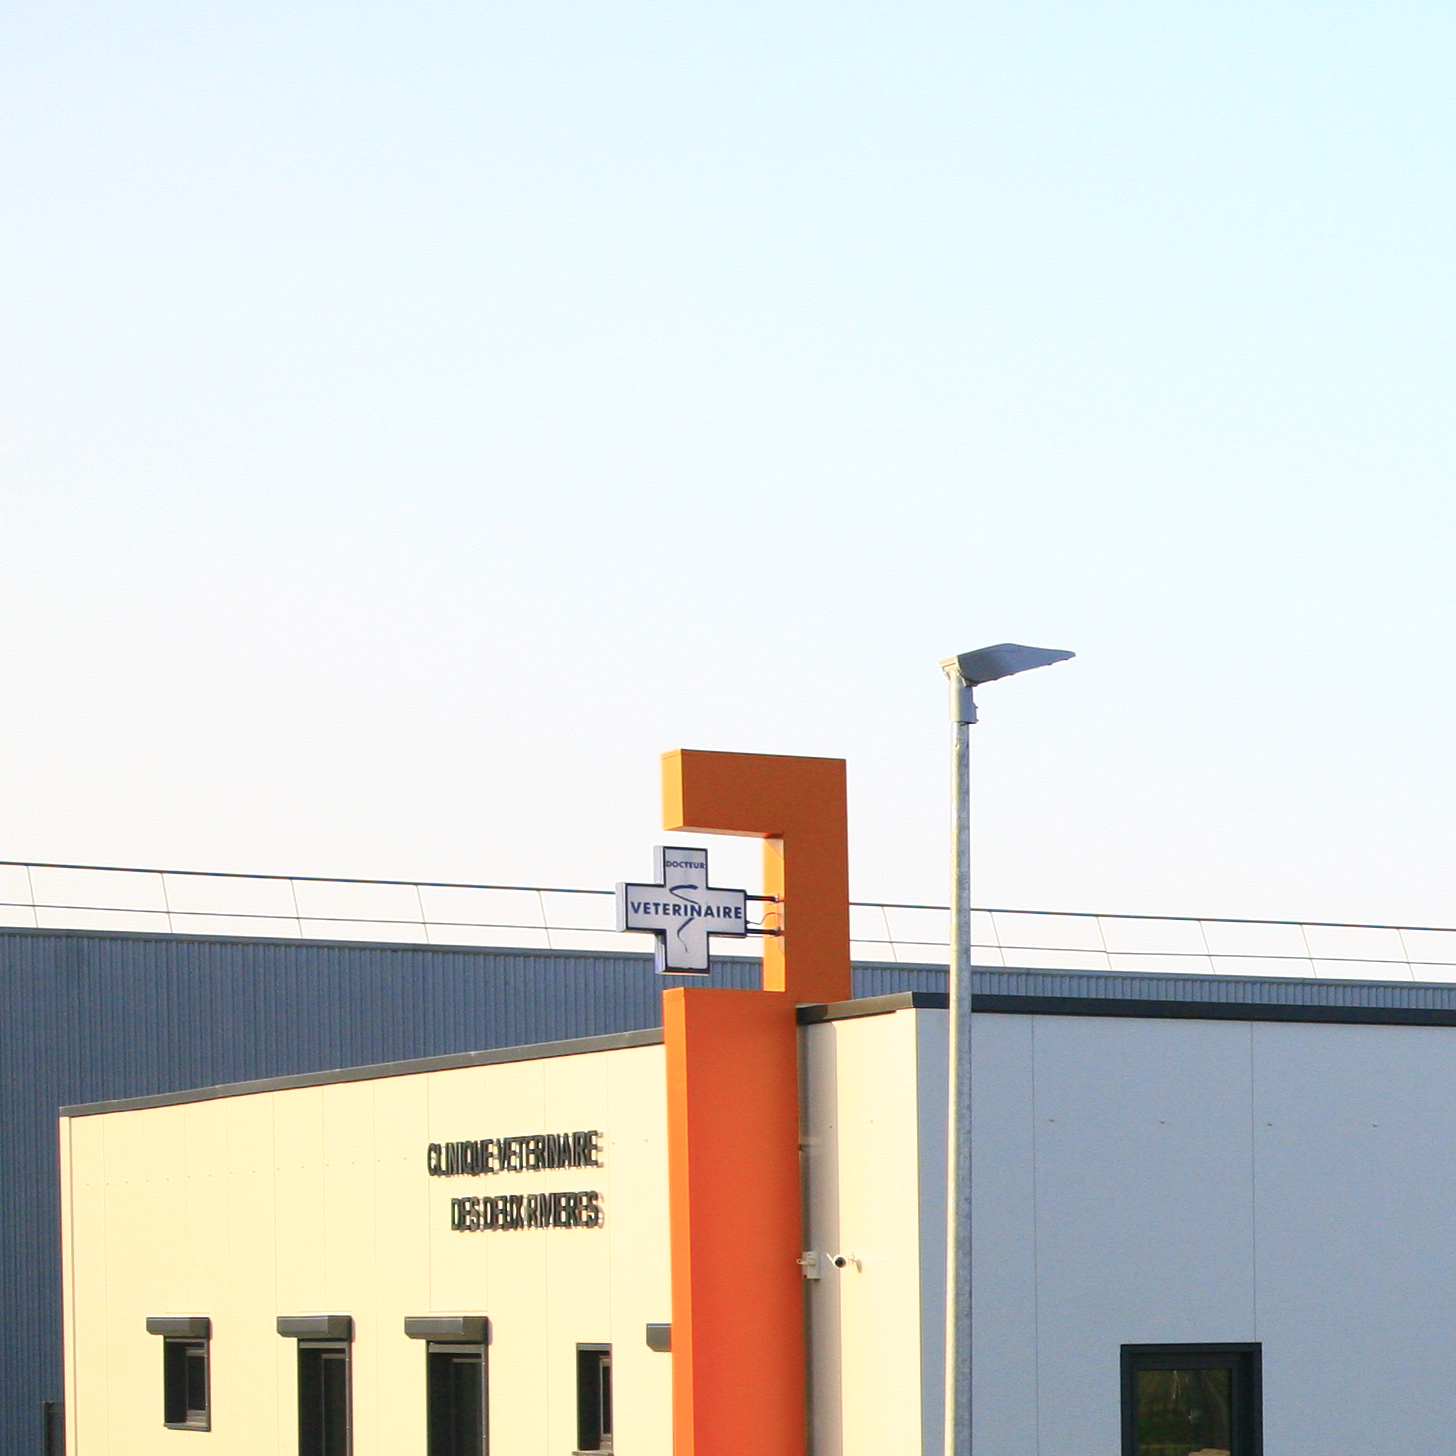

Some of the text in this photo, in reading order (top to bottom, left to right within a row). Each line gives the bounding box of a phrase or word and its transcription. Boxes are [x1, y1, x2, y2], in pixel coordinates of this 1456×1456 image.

[666, 860, 706, 869] DOCTEUR
[630, 901, 743, 919] VETERINAIRE
[427, 1130, 602, 1176] CLINIQUE VETERINAIRE
[451, 1190, 602, 1232] DES DEUX RIVIERES
